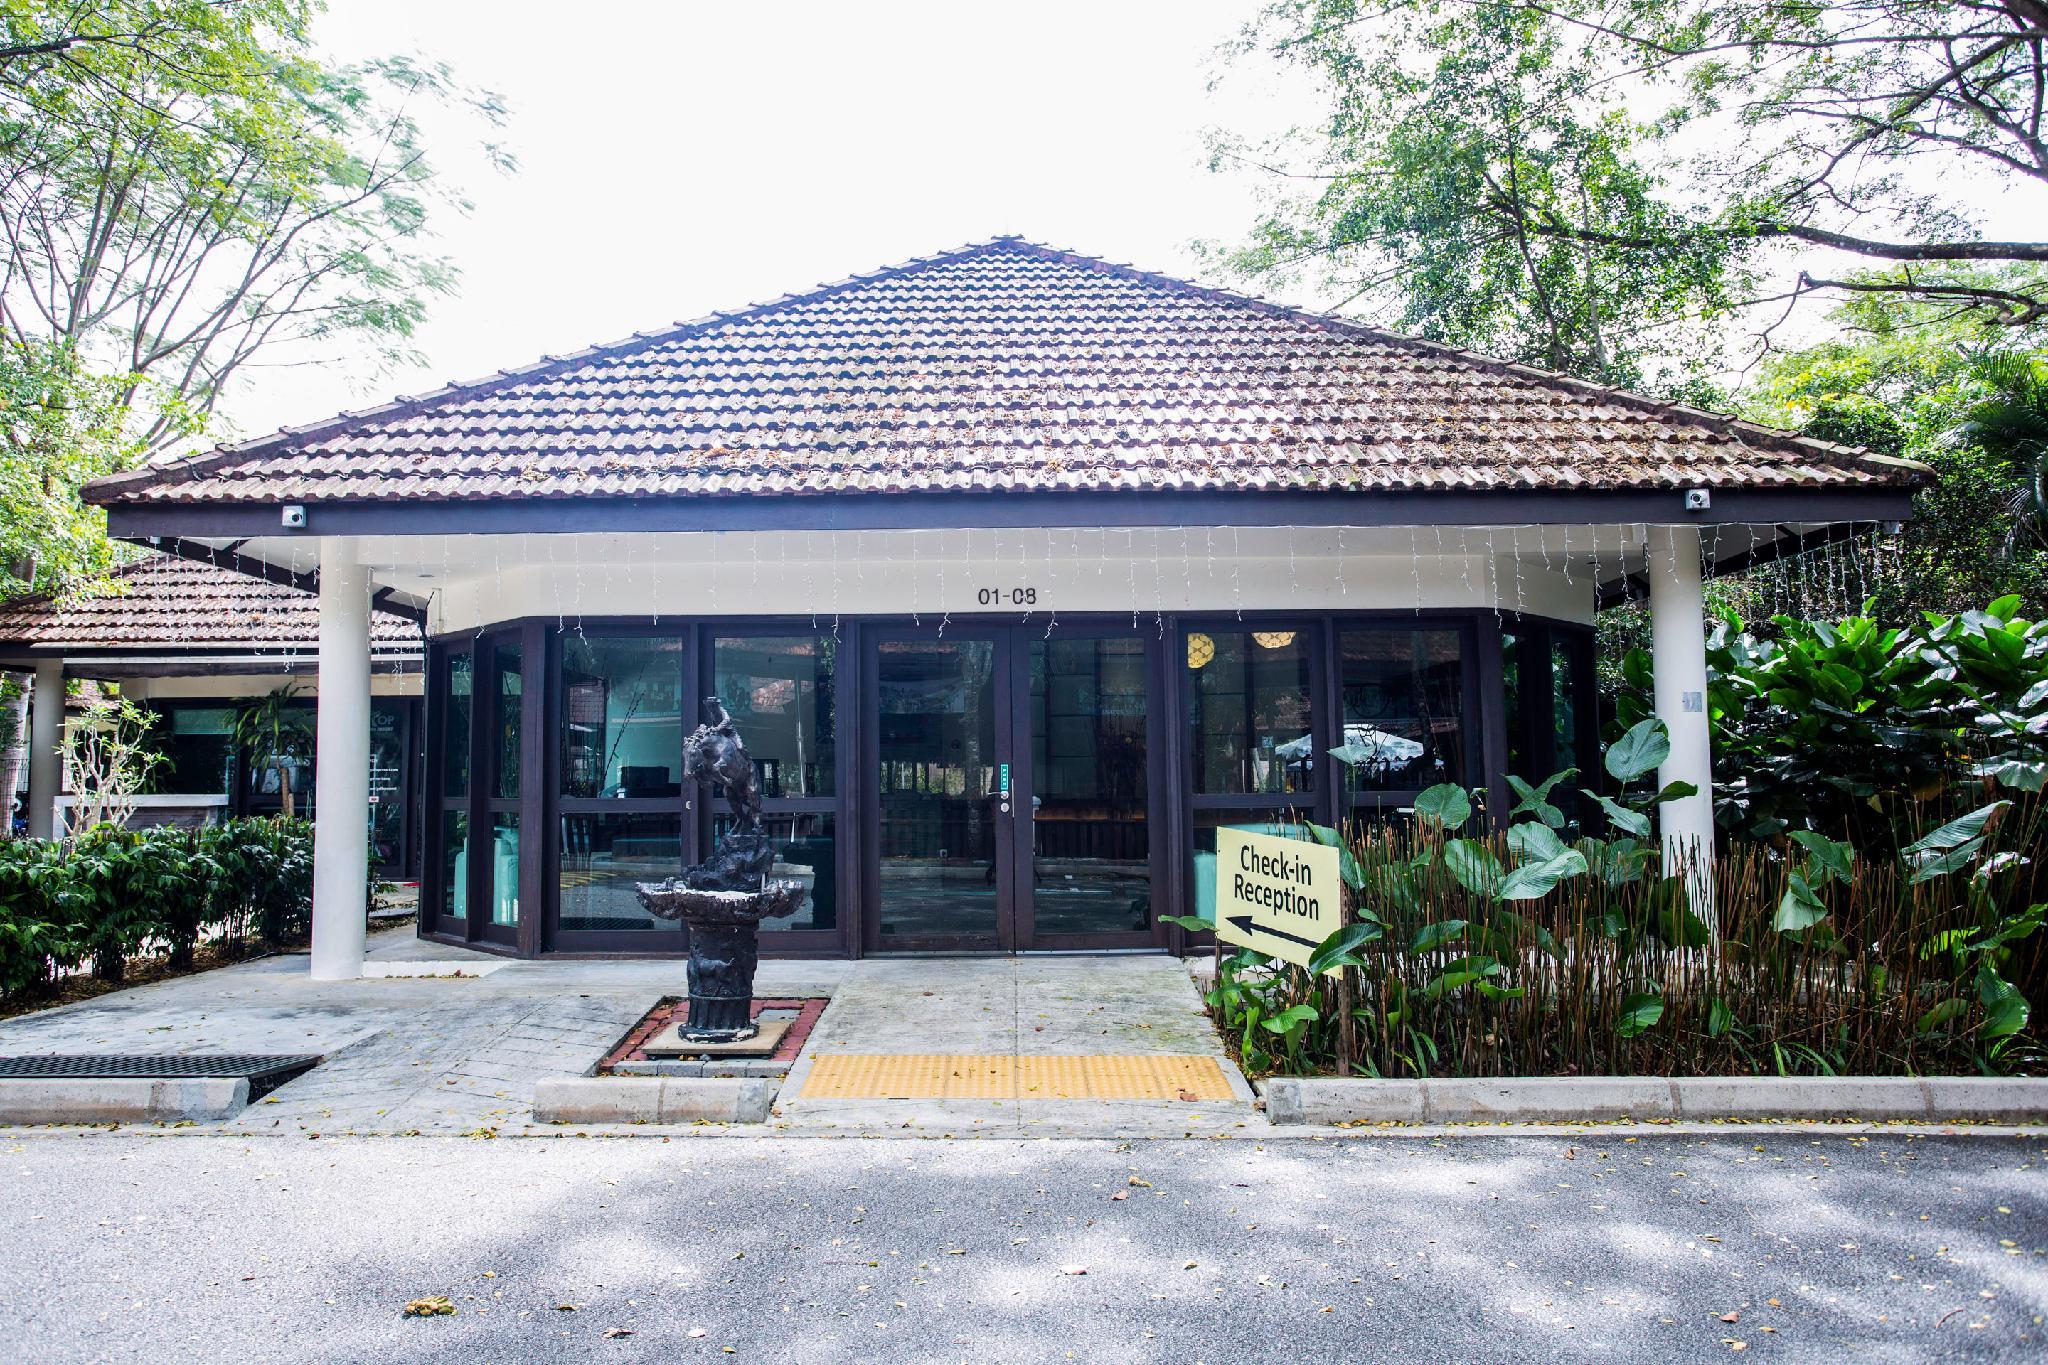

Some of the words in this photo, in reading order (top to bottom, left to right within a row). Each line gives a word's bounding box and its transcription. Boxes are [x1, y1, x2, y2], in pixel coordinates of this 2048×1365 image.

[978, 588, 1036, 605] 01-08
[1241, 845, 1312, 886] Check-in
[1234, 873, 1319, 921] Reception
